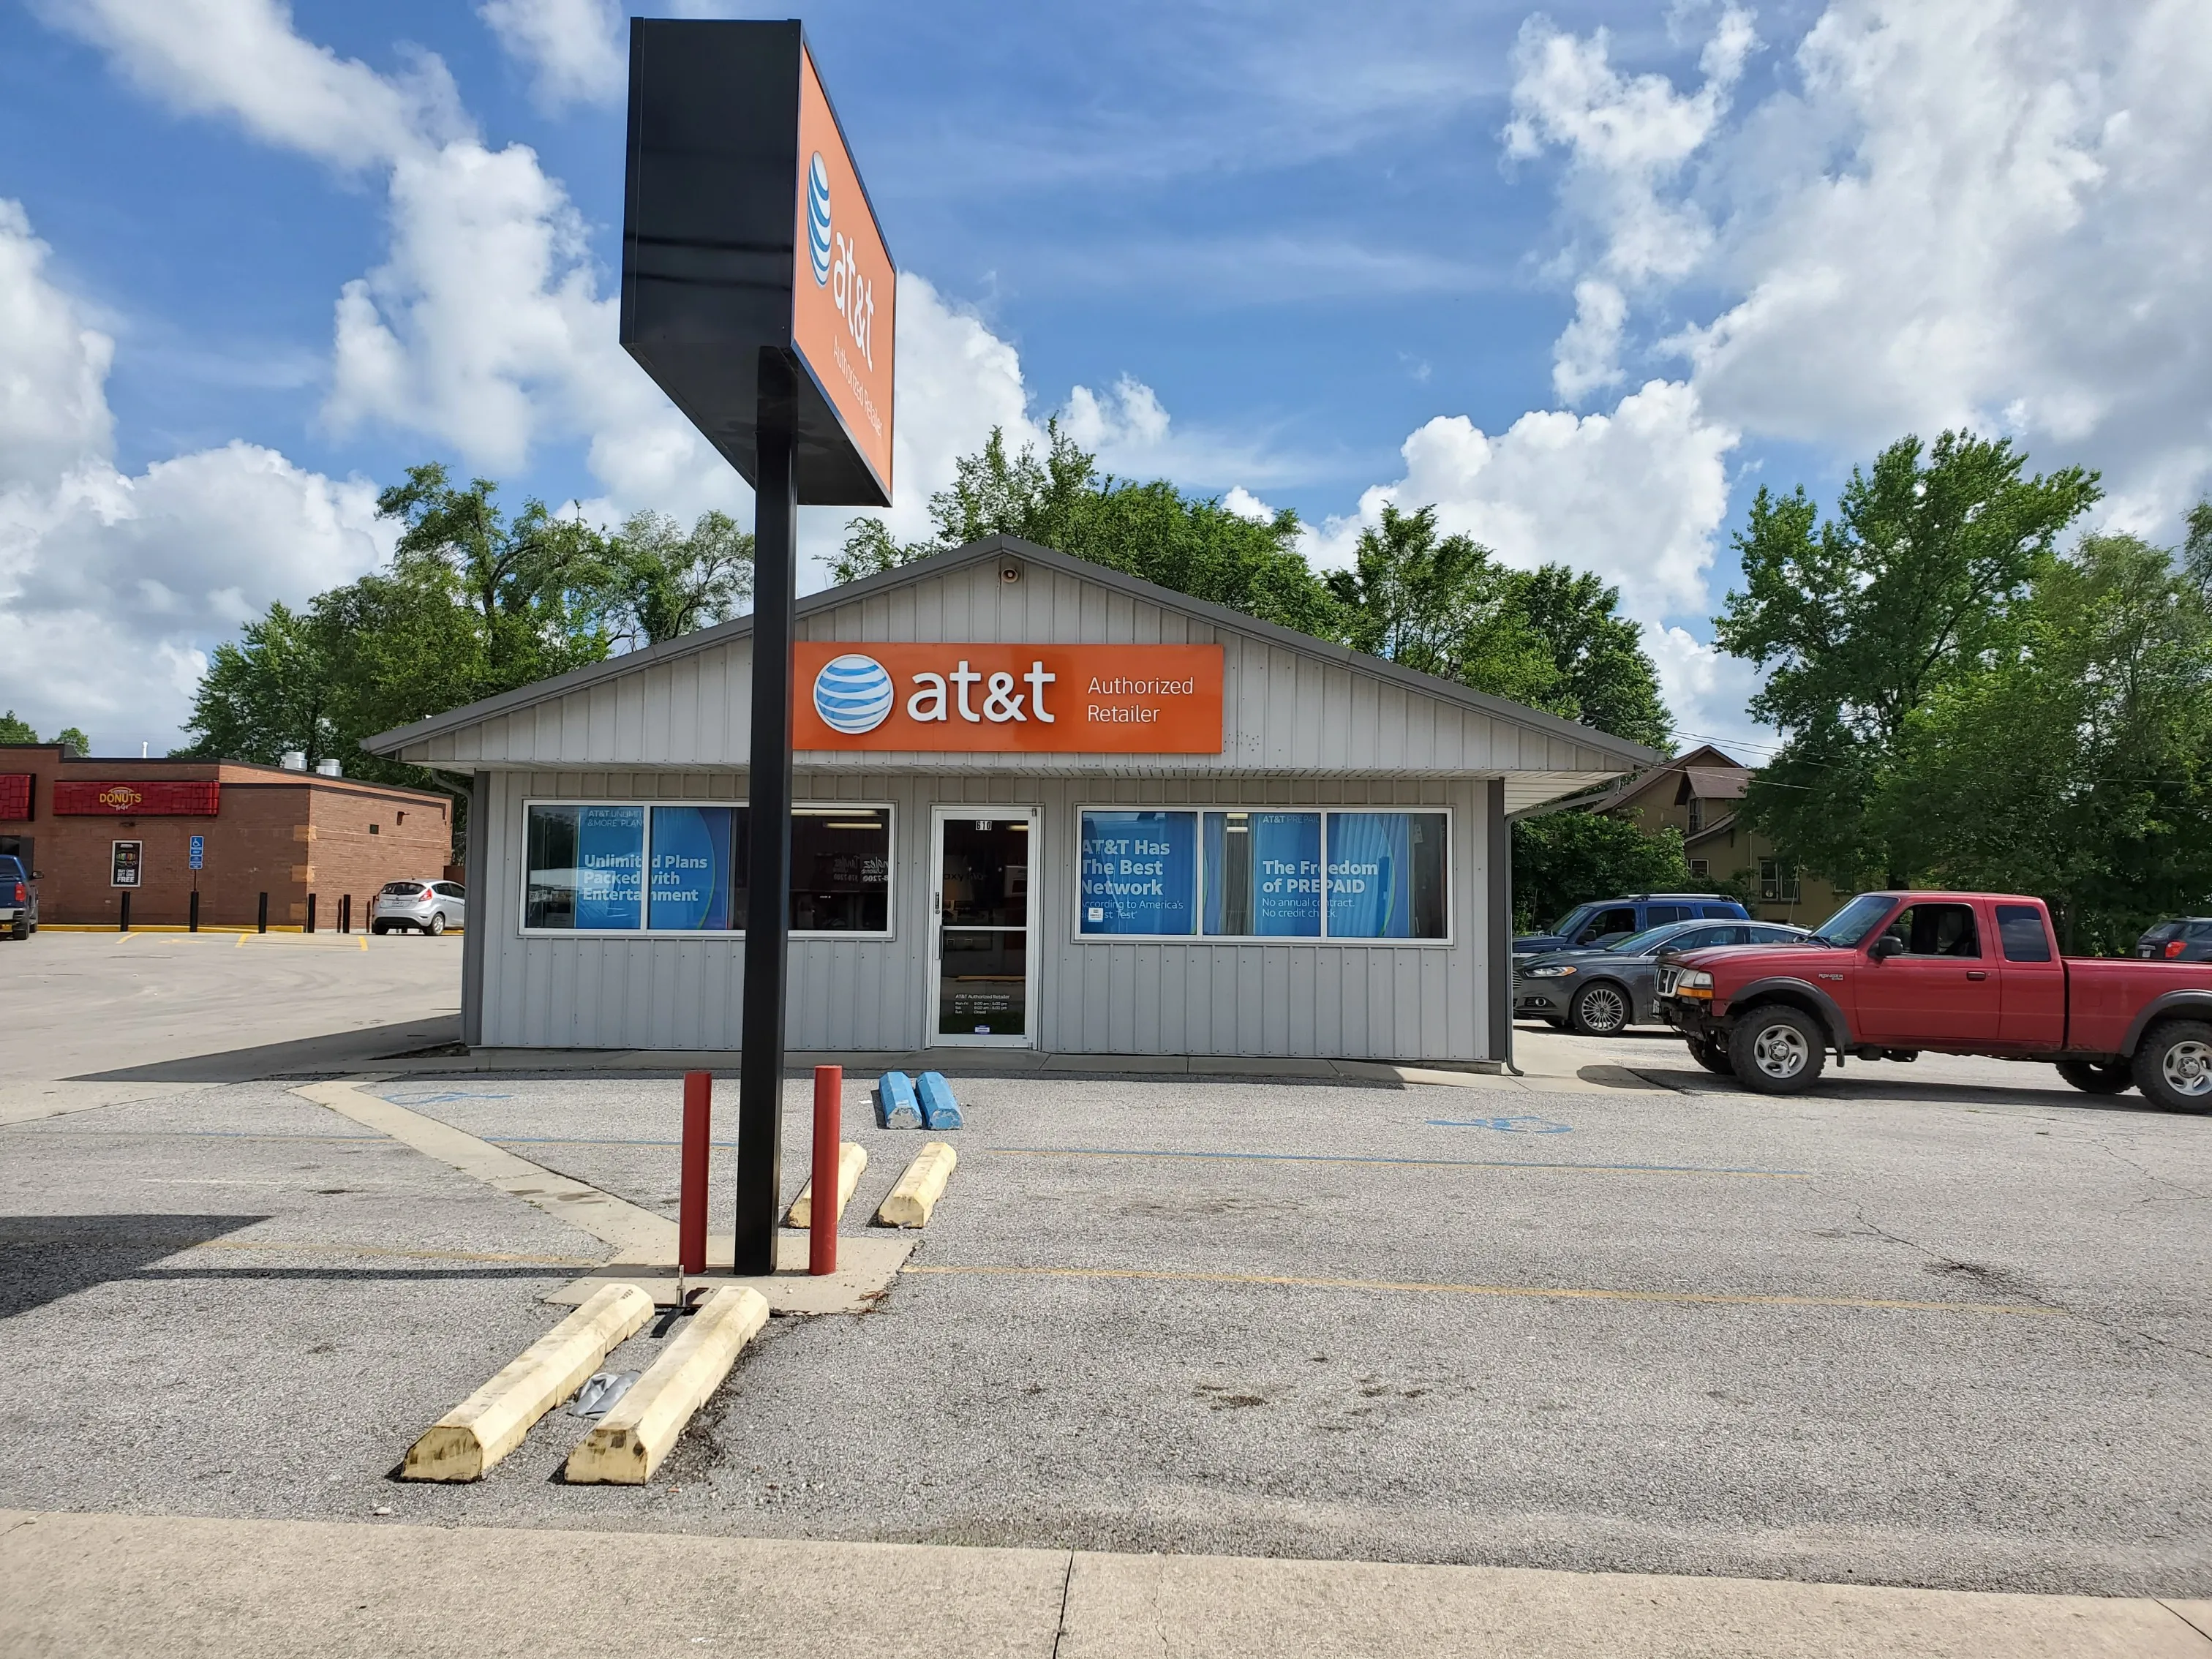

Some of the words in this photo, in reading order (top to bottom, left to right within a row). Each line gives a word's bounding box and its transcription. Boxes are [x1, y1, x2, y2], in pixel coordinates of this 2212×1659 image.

[833, 232, 873, 372] at&t
[833, 334, 864, 406] Authorized
[864, 389, 882, 439] Retailer
[906, 660, 1056, 723] at&t
[1087, 676, 1194, 696] Authorized
[1087, 704, 1161, 723] Retailer
[99, 793, 142, 803] DONUTS
[611, 810, 642, 818] UNLIMIT
[1263, 815, 1286, 824] AT&T
[976, 821, 991, 830] 610
[1082, 839, 1129, 855] AT&T
[1135, 840, 1170, 855] Has
[584, 854, 661, 868] Unlimitd
[665, 854, 707, 869] Plans
[1082, 859, 1114, 875] The
[1120, 859, 1163, 876] Best
[1263, 859, 1295, 875] The
[1300, 859, 1378, 875] Fredom
[584, 870, 641, 884] Packed
[1082, 879, 1163, 895] Network
[1263, 878, 1283, 893] of
[1287, 879, 1365, 893] PREPAID
[583, 887, 699, 901] Entertanment
[1127, 900, 1137, 908] to
[1139, 900, 1184, 909] America's
[1263, 898, 1276, 907] No
[1278, 898, 1310, 907] annual
[1263, 908, 1276, 917] No
[1278, 908, 1306, 917] credit
[1308, 908, 1338, 918] chck.
